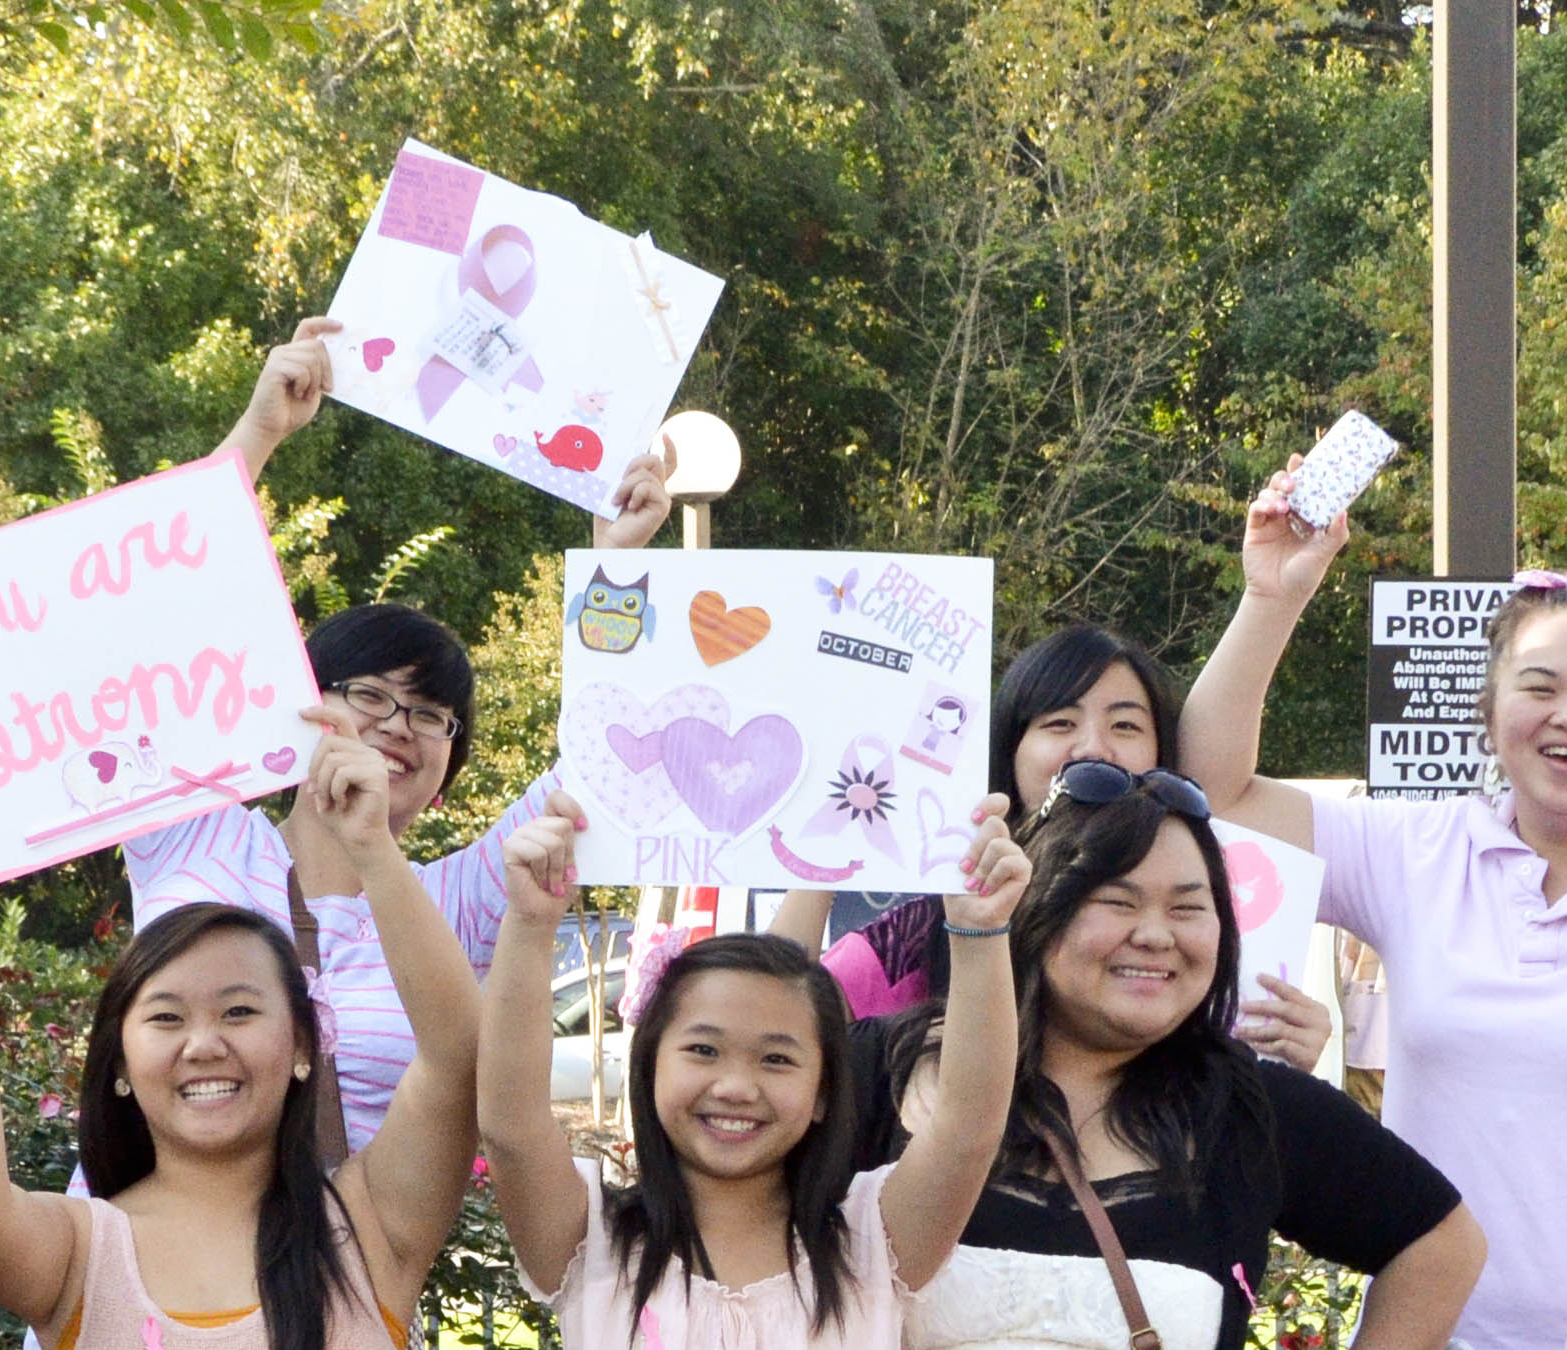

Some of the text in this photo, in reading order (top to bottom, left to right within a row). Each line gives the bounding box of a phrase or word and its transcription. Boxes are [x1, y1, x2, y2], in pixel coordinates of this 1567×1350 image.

[70, 511, 208, 599] are
[876, 562, 985, 649] BREAST
[1407, 589, 1514, 612] PRIVA
[857, 587, 967, 675] CANCER
[1387, 616, 1490, 639] PROP
[819, 633, 913, 673] OCTOBER
[1409, 648, 1491, 661] Unauthor
[1393, 661, 1486, 675] Abandoned
[1393, 677, 1421, 690] Will
[1429, 677, 1451, 690] Be
[1409, 691, 1479, 704] At Owne
[1402, 706, 1434, 719] And
[1380, 730, 1496, 756] MIDTO
[634, 834, 732, 884] PINK
